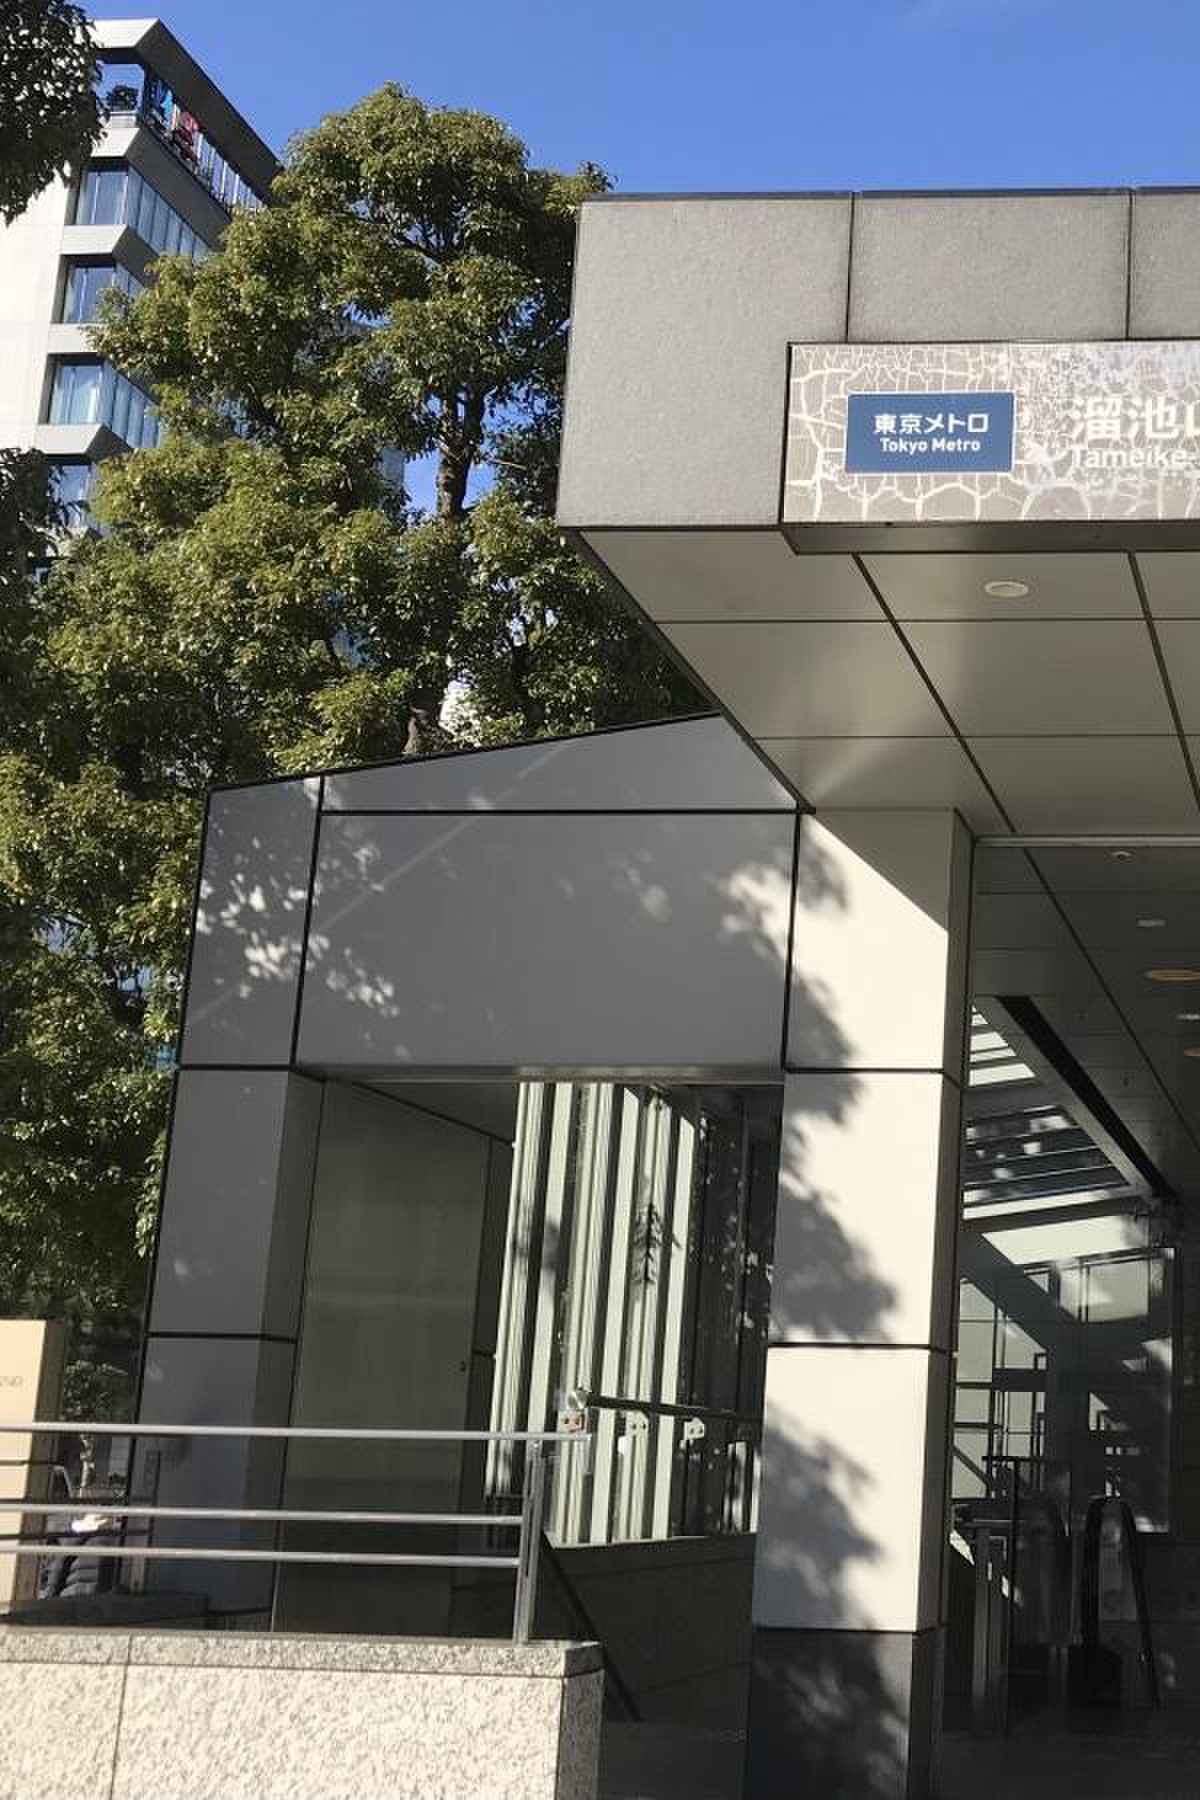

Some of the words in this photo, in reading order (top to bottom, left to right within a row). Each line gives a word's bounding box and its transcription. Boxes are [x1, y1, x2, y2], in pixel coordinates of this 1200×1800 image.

[872, 413, 989, 435] 東京メトロ
[880, 438, 928, 455] Tokyo
[932, 438, 981, 452] Metro
